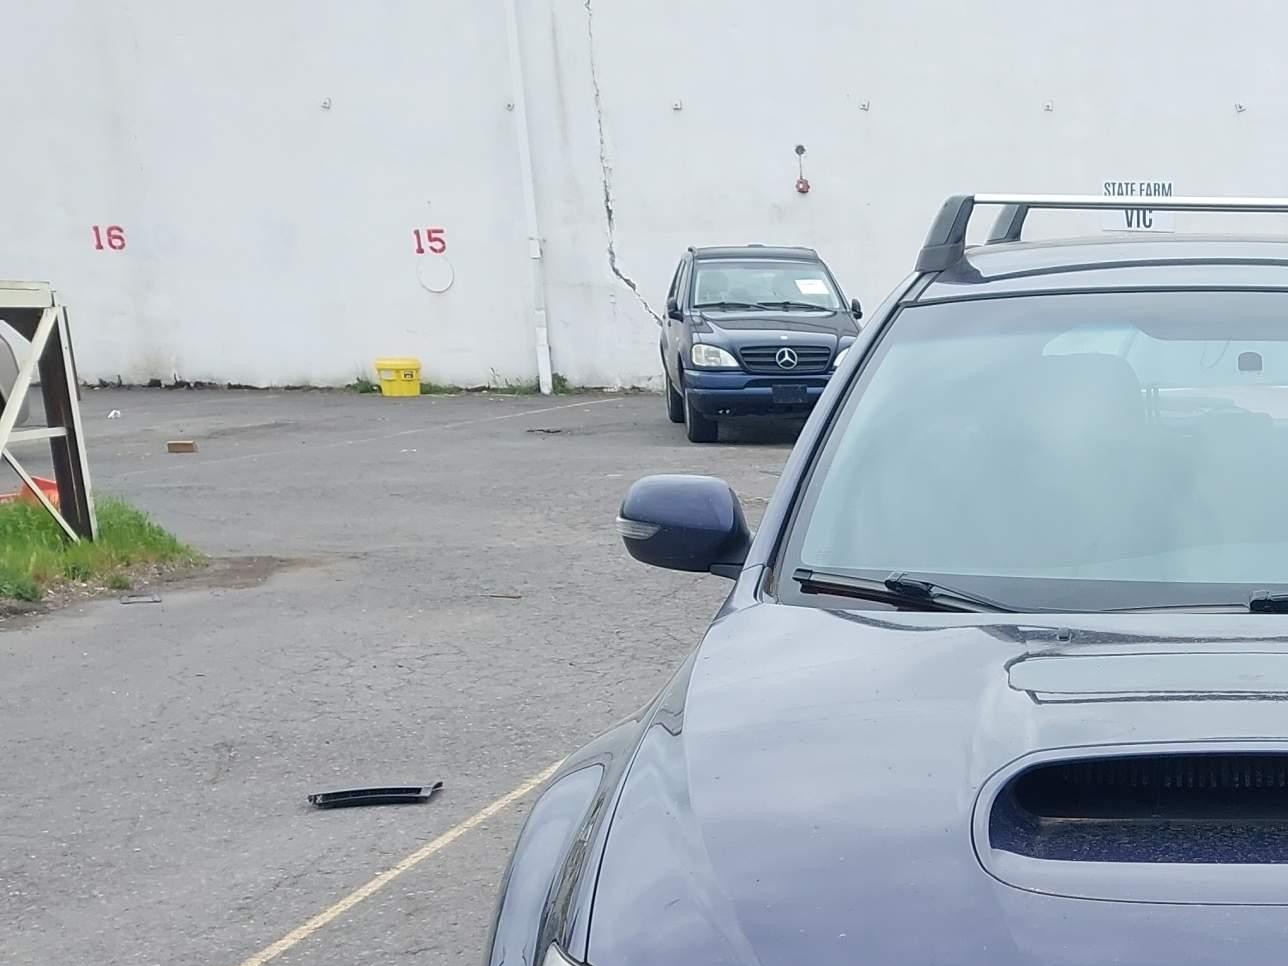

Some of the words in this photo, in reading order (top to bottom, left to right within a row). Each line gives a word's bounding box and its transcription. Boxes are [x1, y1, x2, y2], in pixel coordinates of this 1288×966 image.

[1104, 182, 1136, 196] STATE
[1140, 182, 1172, 197] FARM
[1125, 208, 1153, 228] VIC
[92, 225, 126, 250] 16
[414, 229, 446, 254] 15
